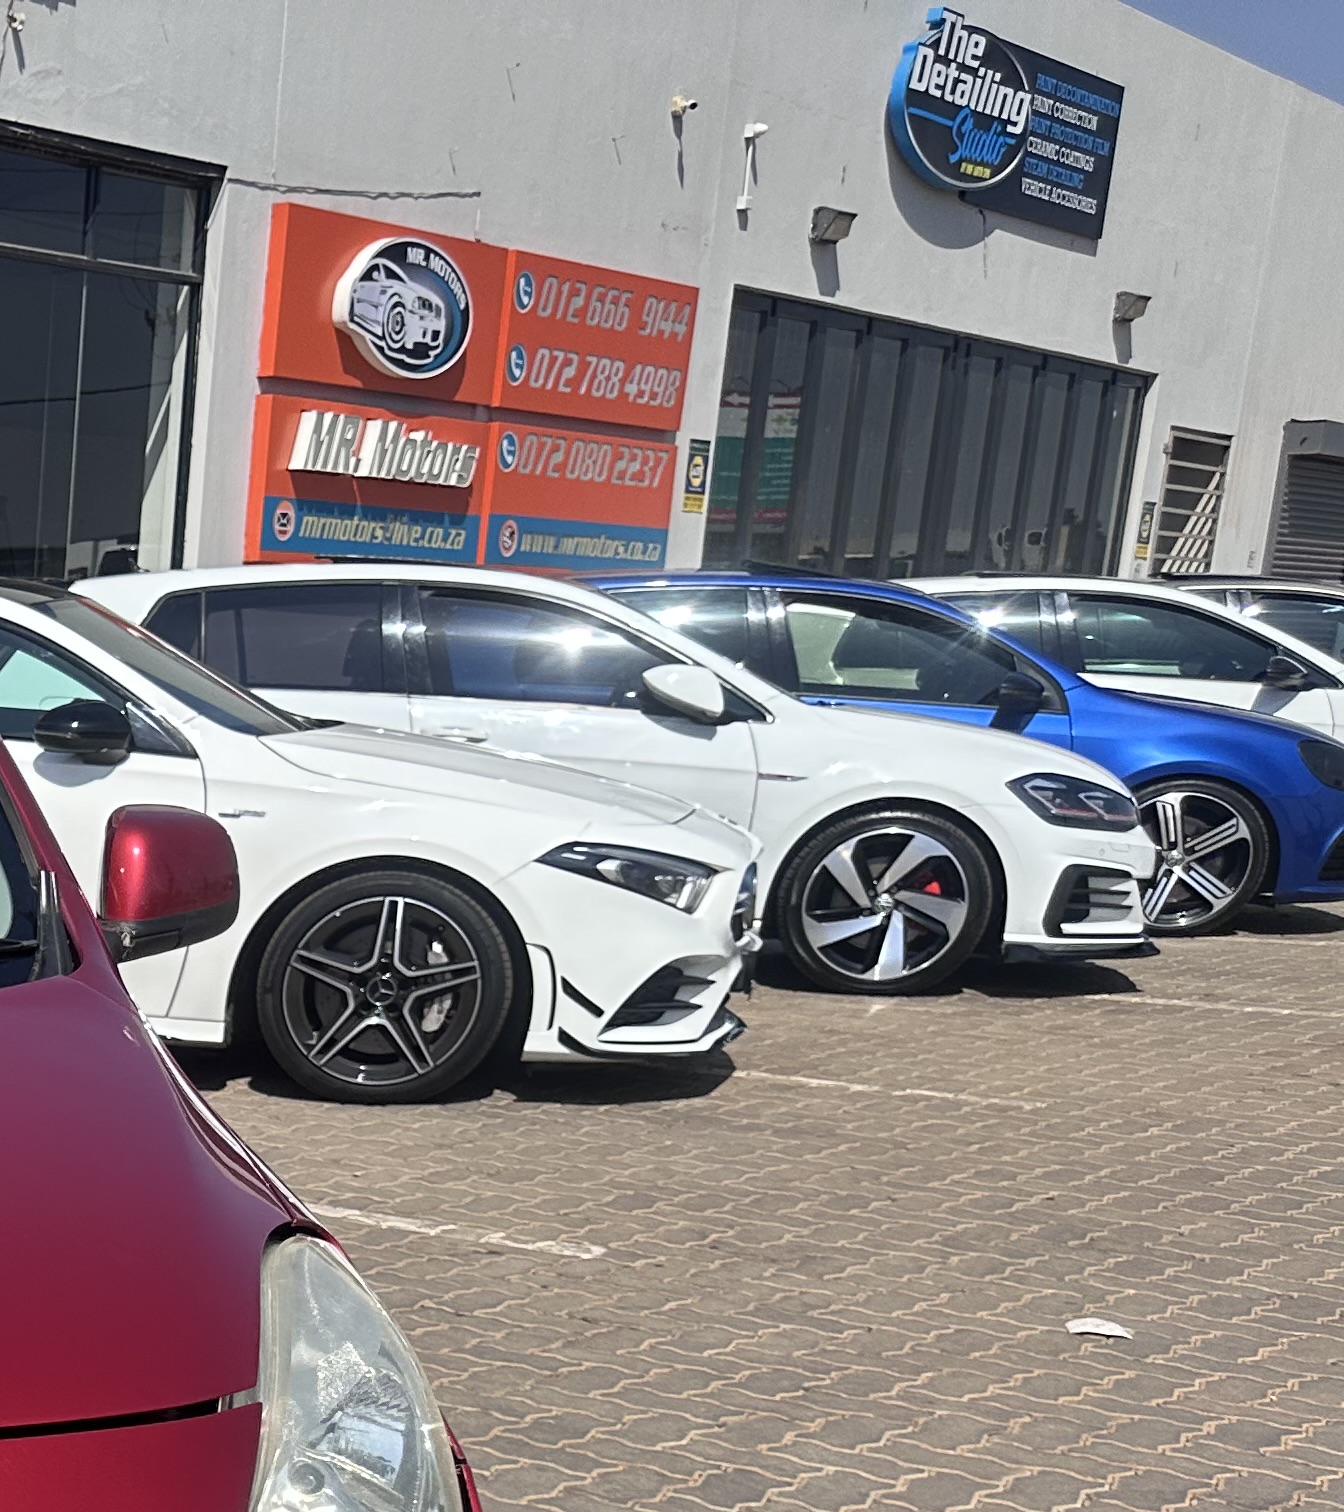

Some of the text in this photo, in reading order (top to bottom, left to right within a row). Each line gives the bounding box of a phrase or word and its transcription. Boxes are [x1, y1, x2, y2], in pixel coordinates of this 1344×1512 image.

[938, 9, 987, 69] The
[908, 45, 1032, 135] Detailing
[405, 246, 467, 311] MR. MOTORS
[537, 274, 692, 343] 012 666 9144
[529, 345, 682, 408] 072 788 4998
[288, 410, 481, 488] MR. Motors
[517, 432, 568, 478] 072
[565, 439, 613, 483] 080
[611, 445, 670, 489] 2237
[520, 531, 662, 562] www.mrmotors.co.za
